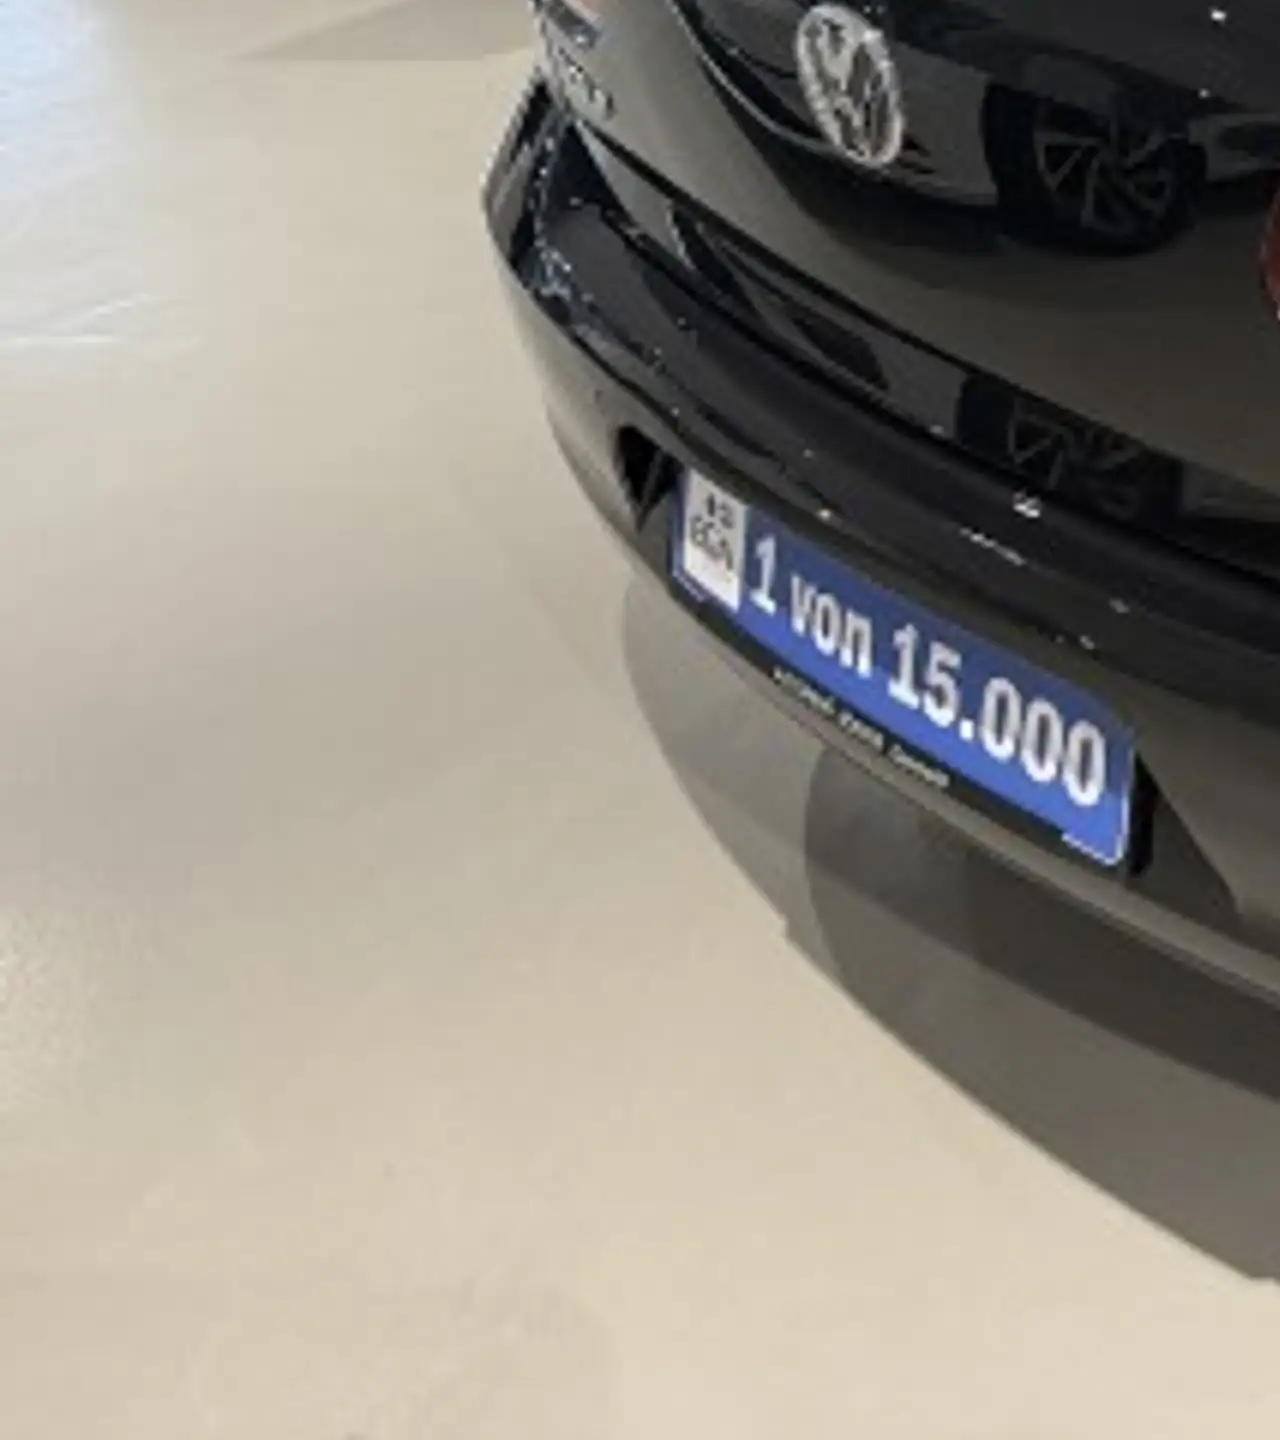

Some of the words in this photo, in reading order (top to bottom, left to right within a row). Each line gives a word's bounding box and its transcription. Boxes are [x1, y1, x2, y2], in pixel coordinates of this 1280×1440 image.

[750, 535, 777, 616] 1
[790, 574, 873, 679] von
[887, 622, 1106, 808] 15.000
